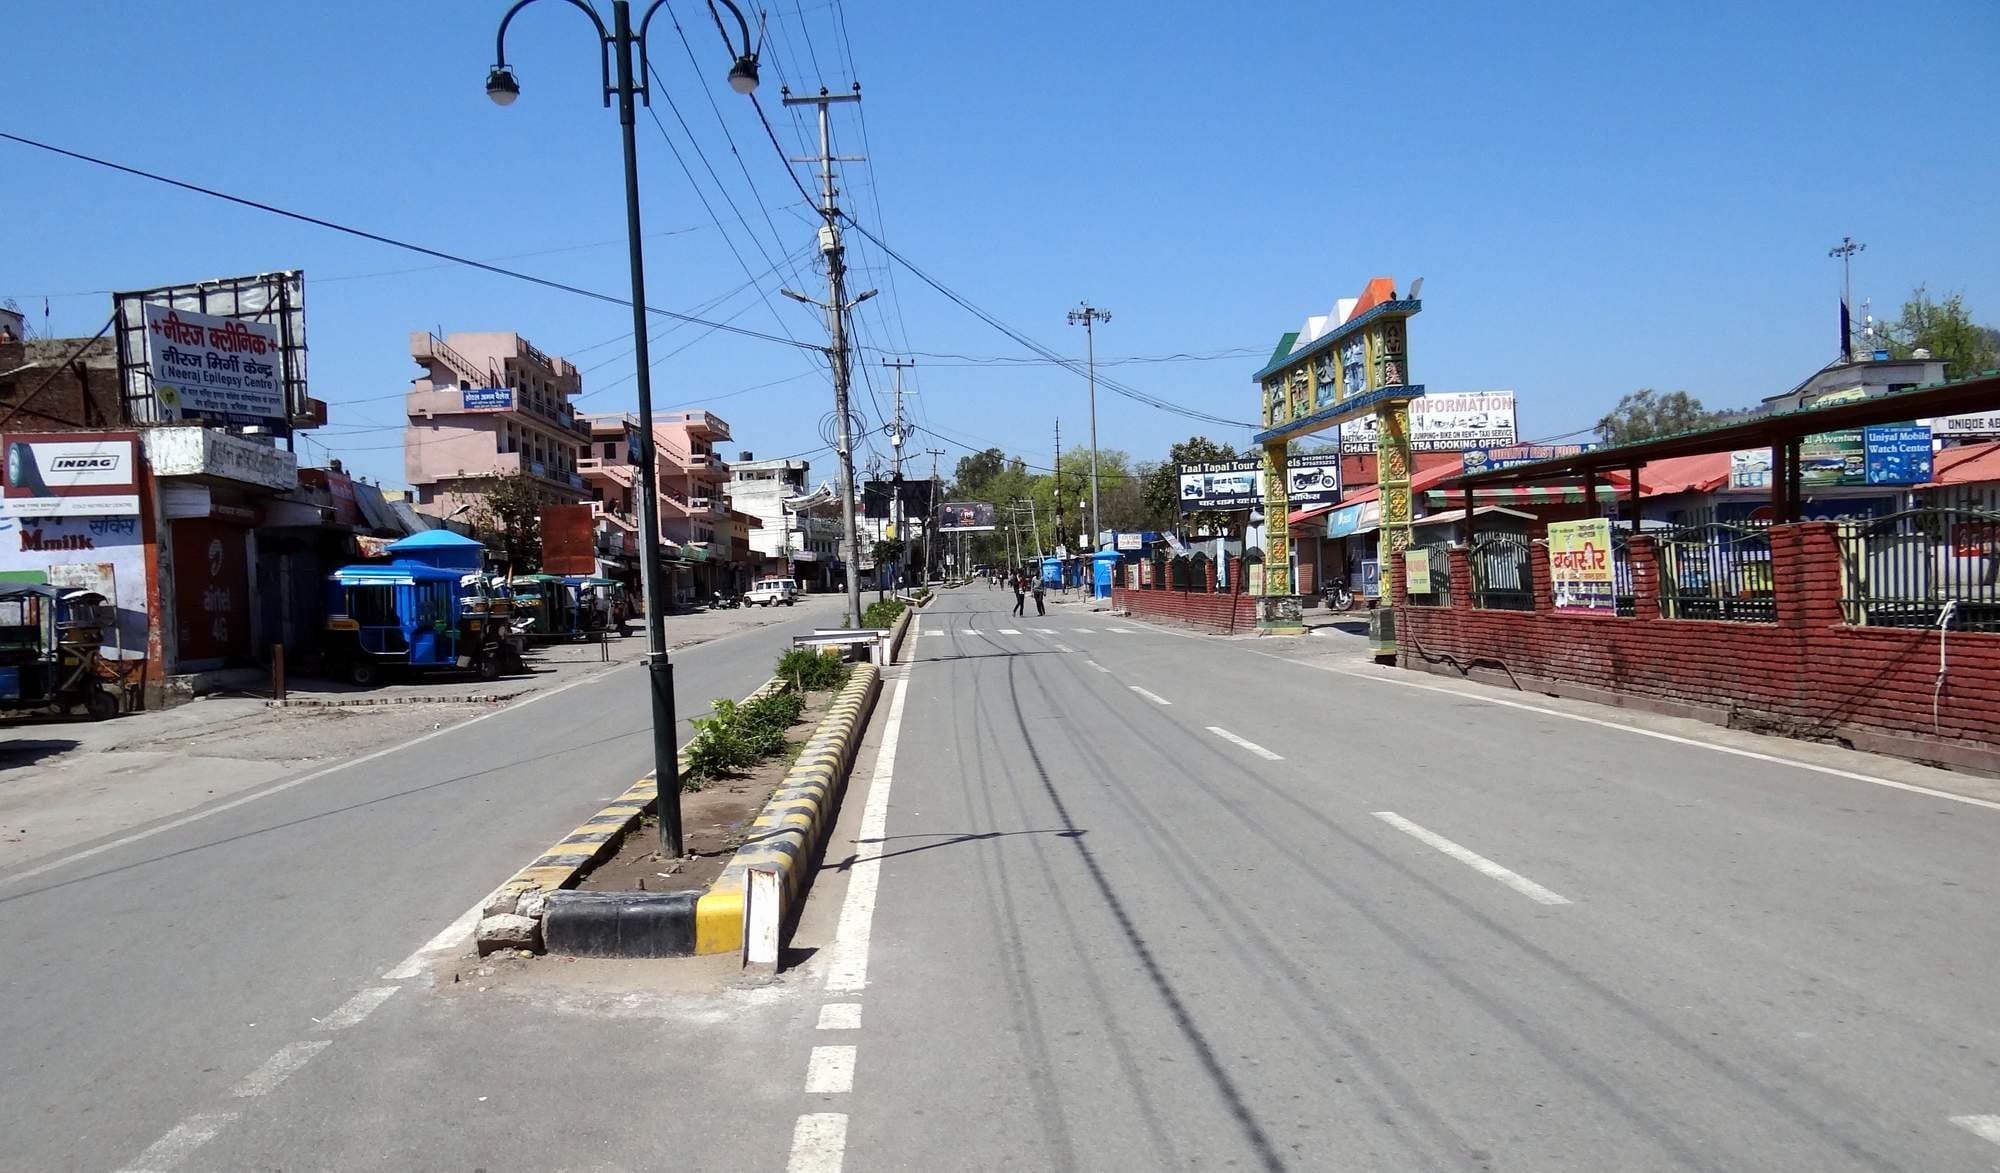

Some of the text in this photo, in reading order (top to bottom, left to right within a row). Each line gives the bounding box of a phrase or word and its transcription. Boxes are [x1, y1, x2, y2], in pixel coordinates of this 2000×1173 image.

[162, 312, 267, 356] नीरज क्लीनिक
[162, 347, 202, 365] नीरज
[242, 358, 273, 379] केन्द्र
[168, 366, 201, 384] Neeraj
[203, 370, 241, 389] Epilepsy
[244, 376, 273, 390] Centre
[1411, 398, 1512, 414] INFORMATION
[1948, 418, 1984, 430] UNIQUE
[1440, 431, 1451, 439] BIKE
[1452, 431, 1461, 439] ON
[1491, 429, 1513, 437] SERVICE
[1899, 431, 1929, 441] Mobile
[1344, 442, 1372, 453] CHAR
[1433, 439, 1477, 449] BOOKING
[1478, 437, 1512, 448] OFFICE
[1868, 444, 1898, 453] Watch
[1899, 444, 1930, 452] Center
[57, 459, 111, 468] INDAG
[1181, 464, 1201, 473] Taal
[1202, 462, 1230, 473] Tapal
[1231, 461, 1255, 471] Tour
[1287, 458, 1301, 467] els
